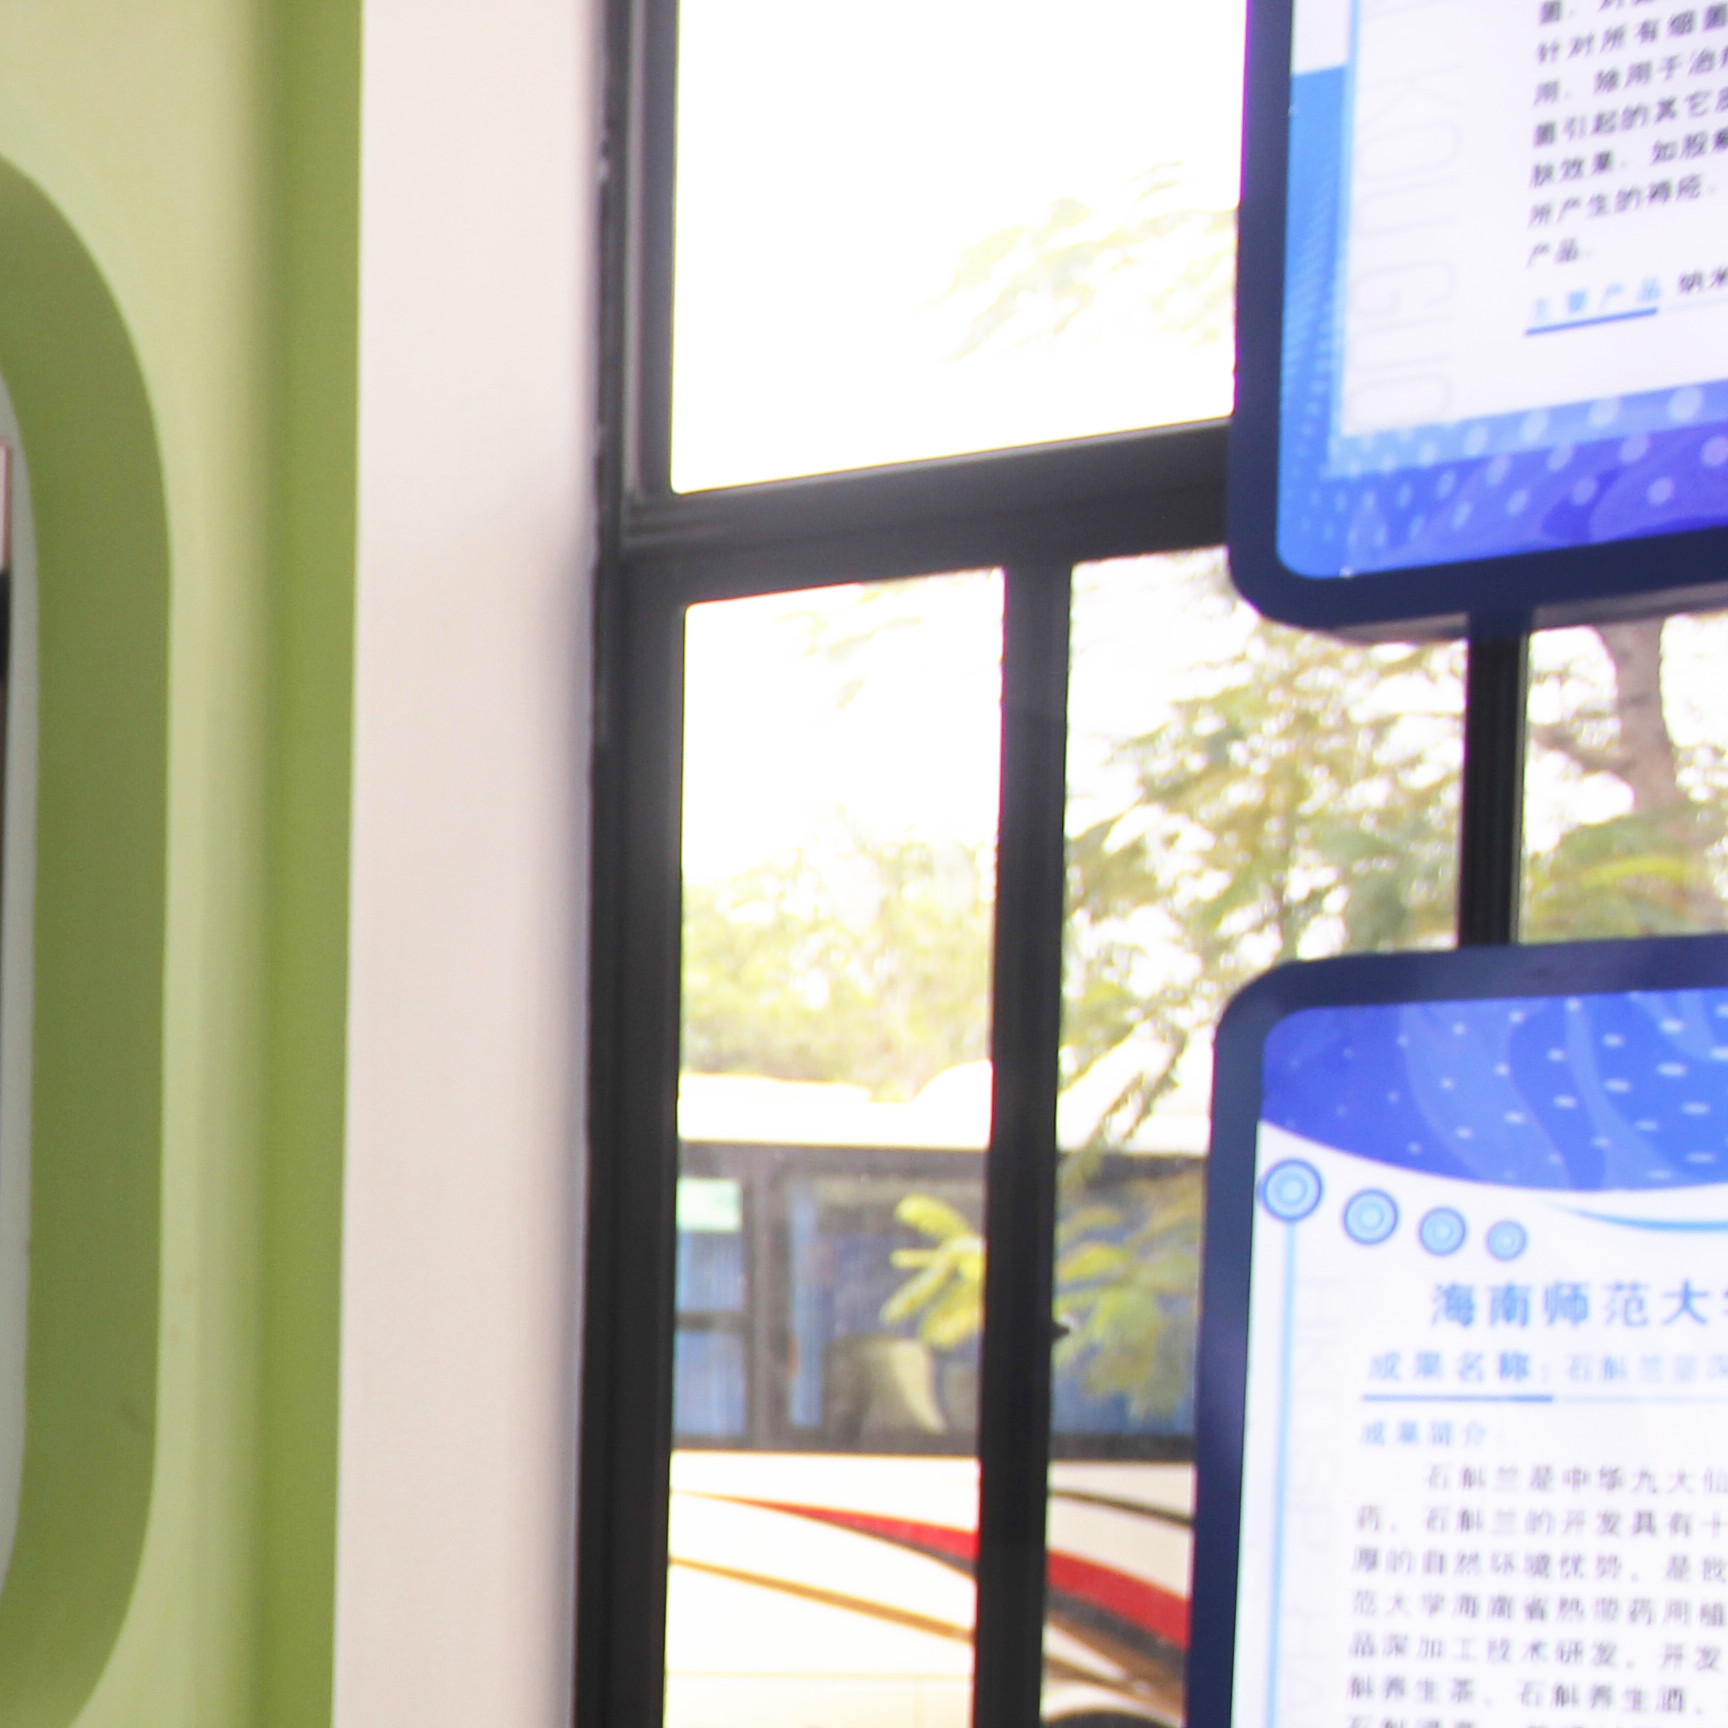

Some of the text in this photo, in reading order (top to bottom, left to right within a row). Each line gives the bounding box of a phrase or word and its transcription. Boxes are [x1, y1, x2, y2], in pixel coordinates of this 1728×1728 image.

[1431, 1279, 1728, 1328] 海南师范大
